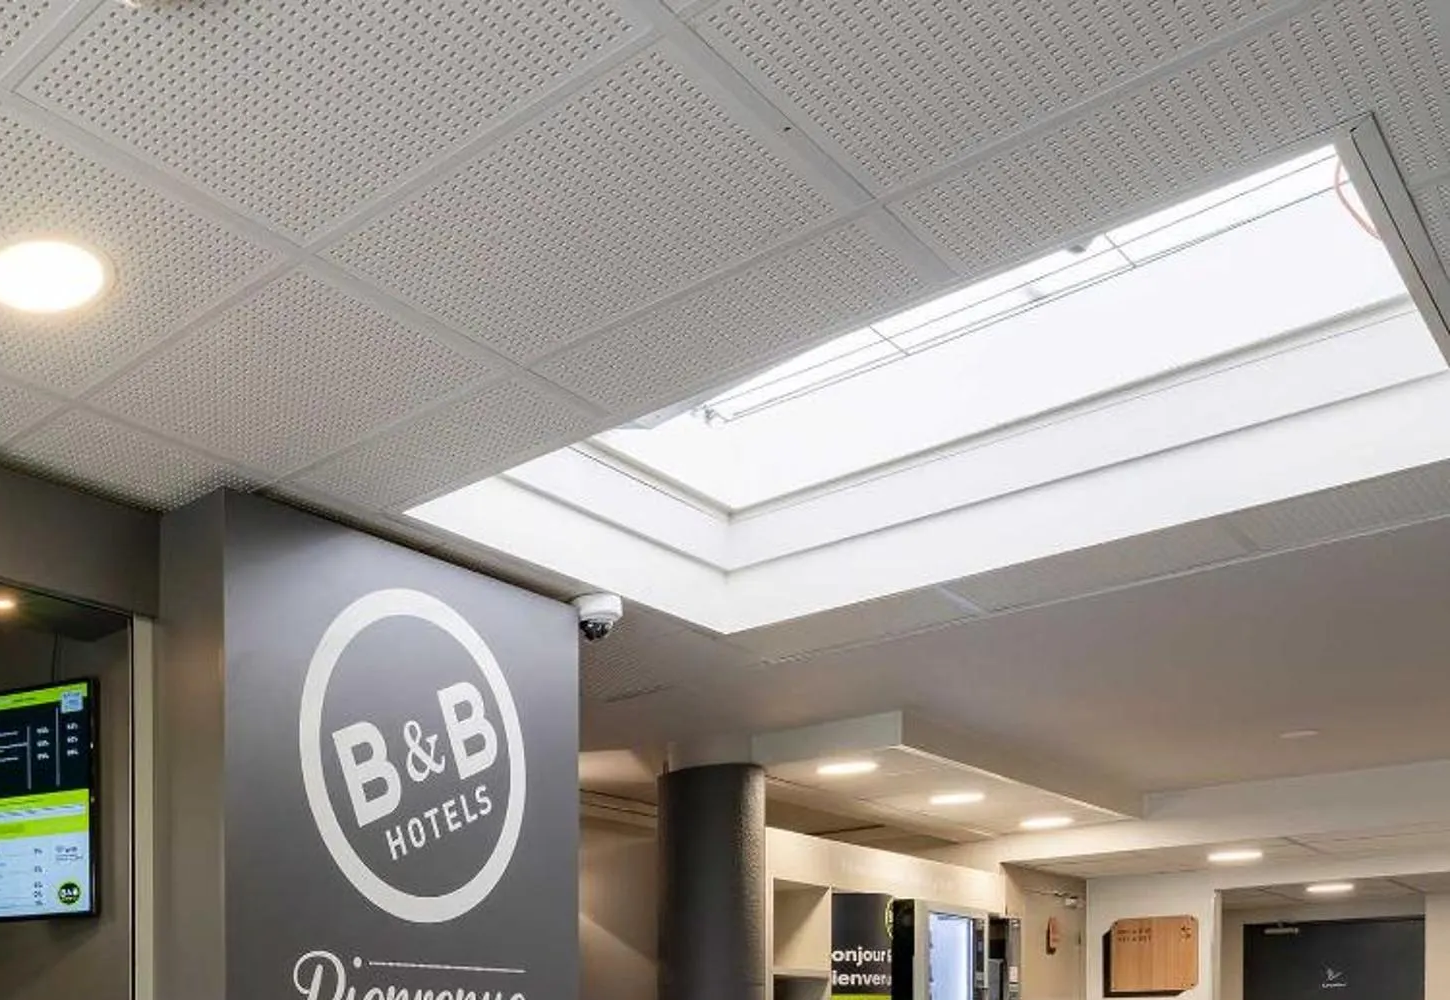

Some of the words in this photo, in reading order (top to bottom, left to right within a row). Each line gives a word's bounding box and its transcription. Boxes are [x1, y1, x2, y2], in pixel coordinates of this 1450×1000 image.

[331, 681, 498, 829] B&B
[384, 784, 493, 861] HOTELS
[831, 946, 886, 967] onjour
